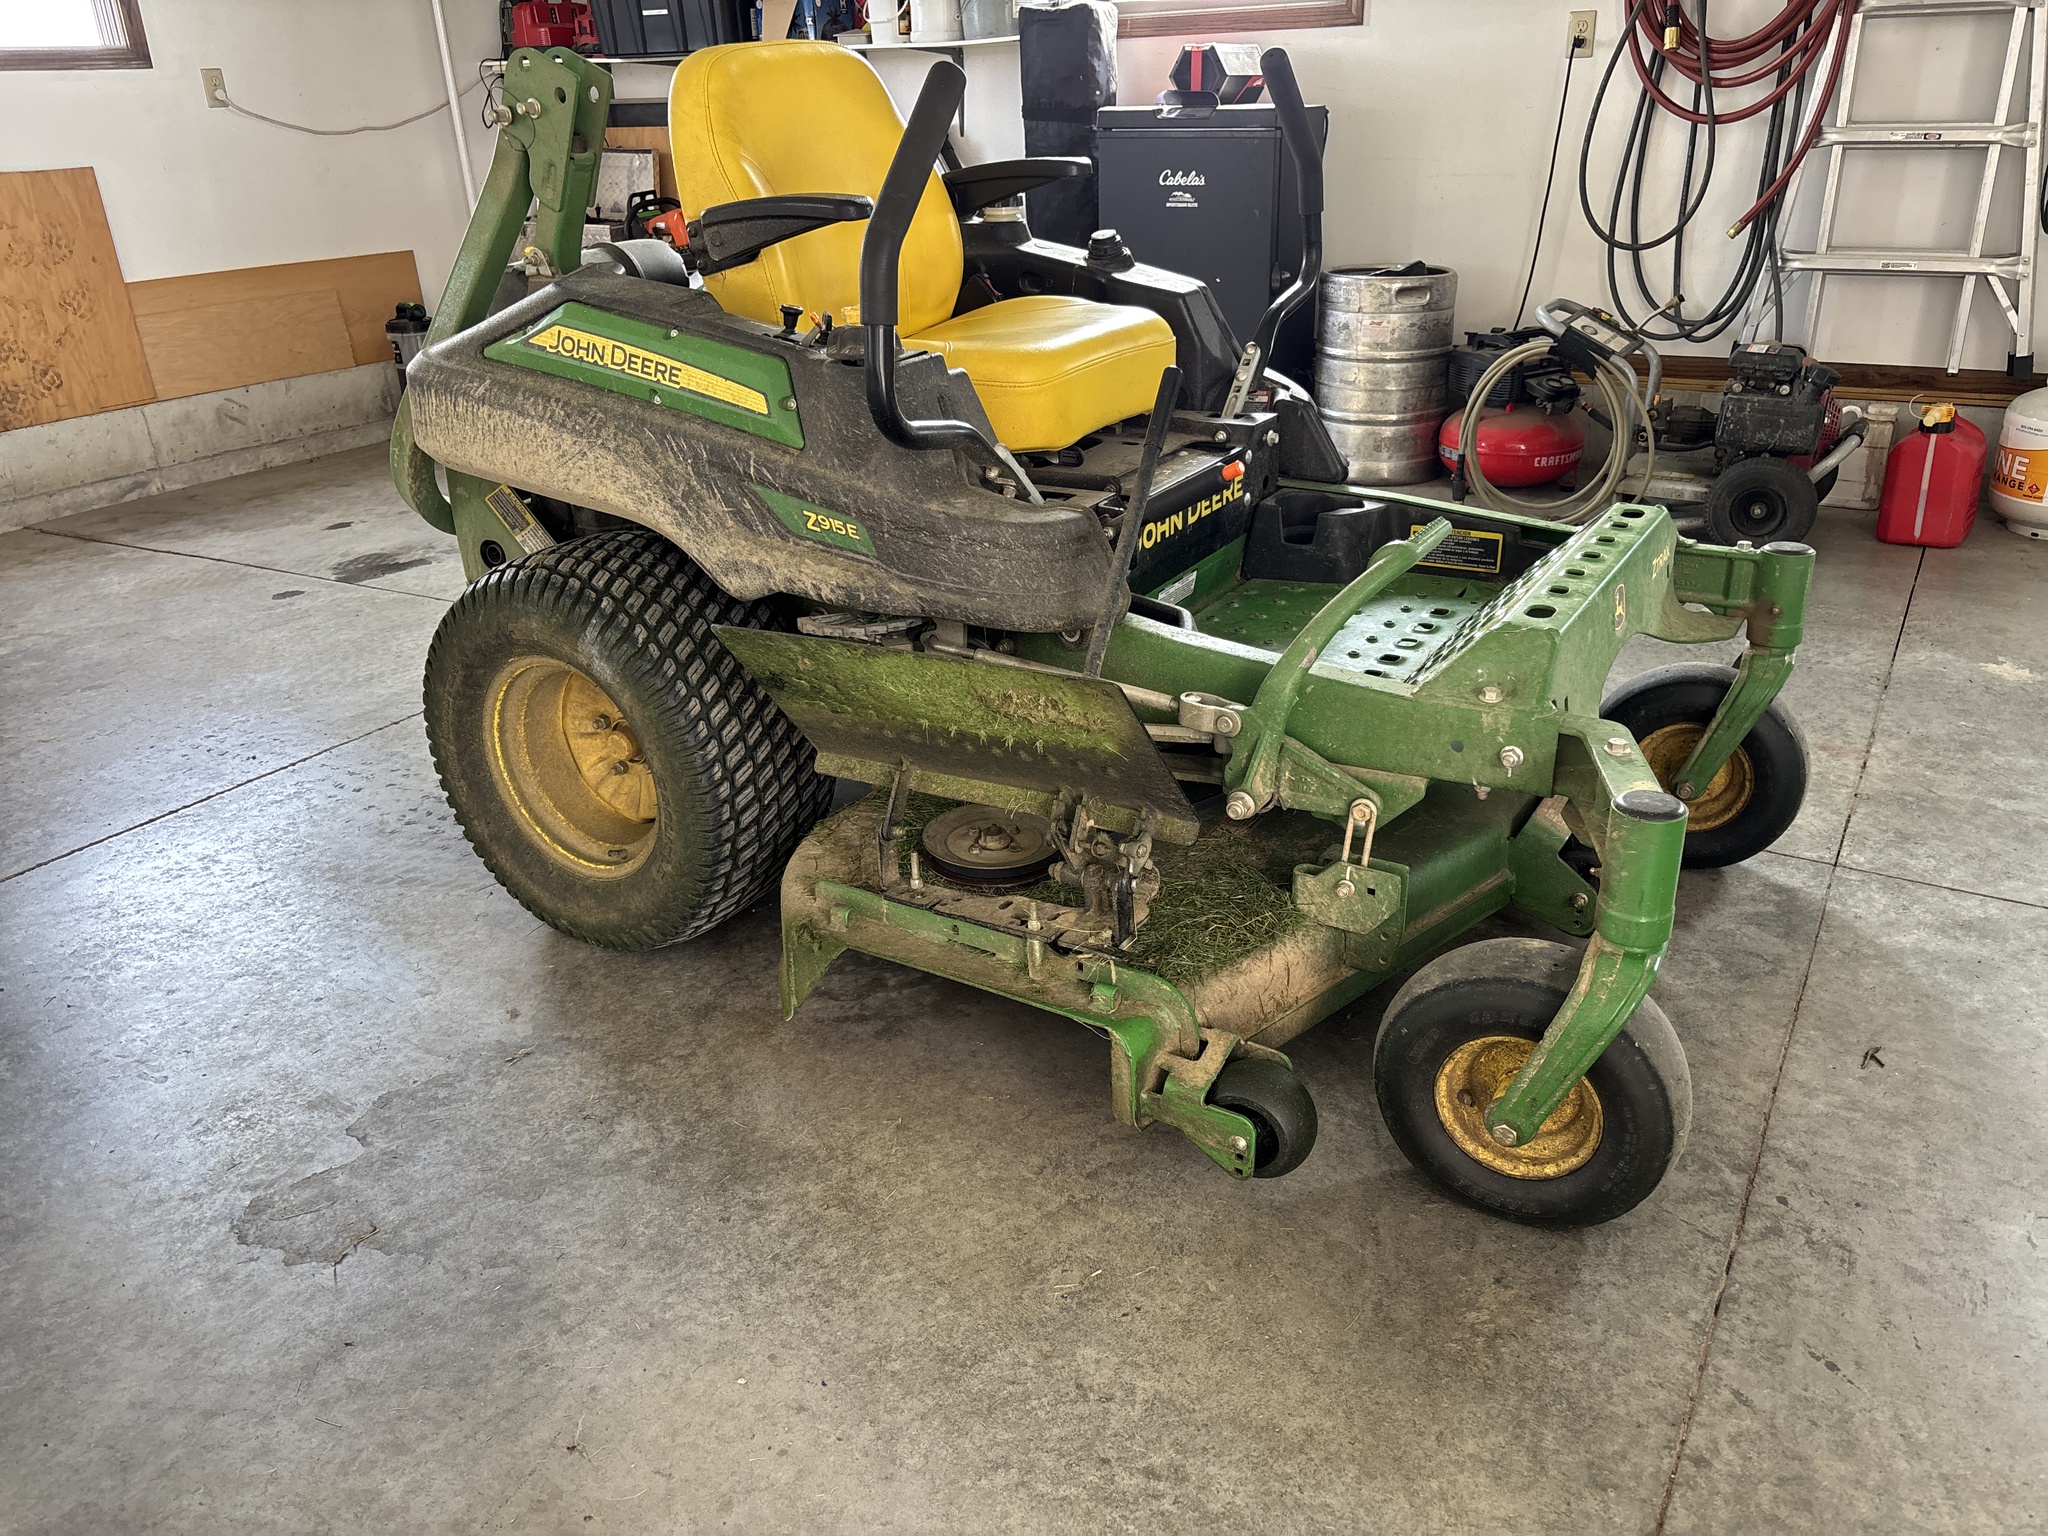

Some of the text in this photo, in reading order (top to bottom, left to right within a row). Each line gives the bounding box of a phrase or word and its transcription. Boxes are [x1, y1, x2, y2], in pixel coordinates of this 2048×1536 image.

[1158, 169, 1206, 186] Cabela's
[548, 329, 683, 387] JOHN DEERE
[1994, 449, 2030, 481] NE
[802, 510, 860, 540] Z915E
[1137, 510, 1183, 551] OHN
